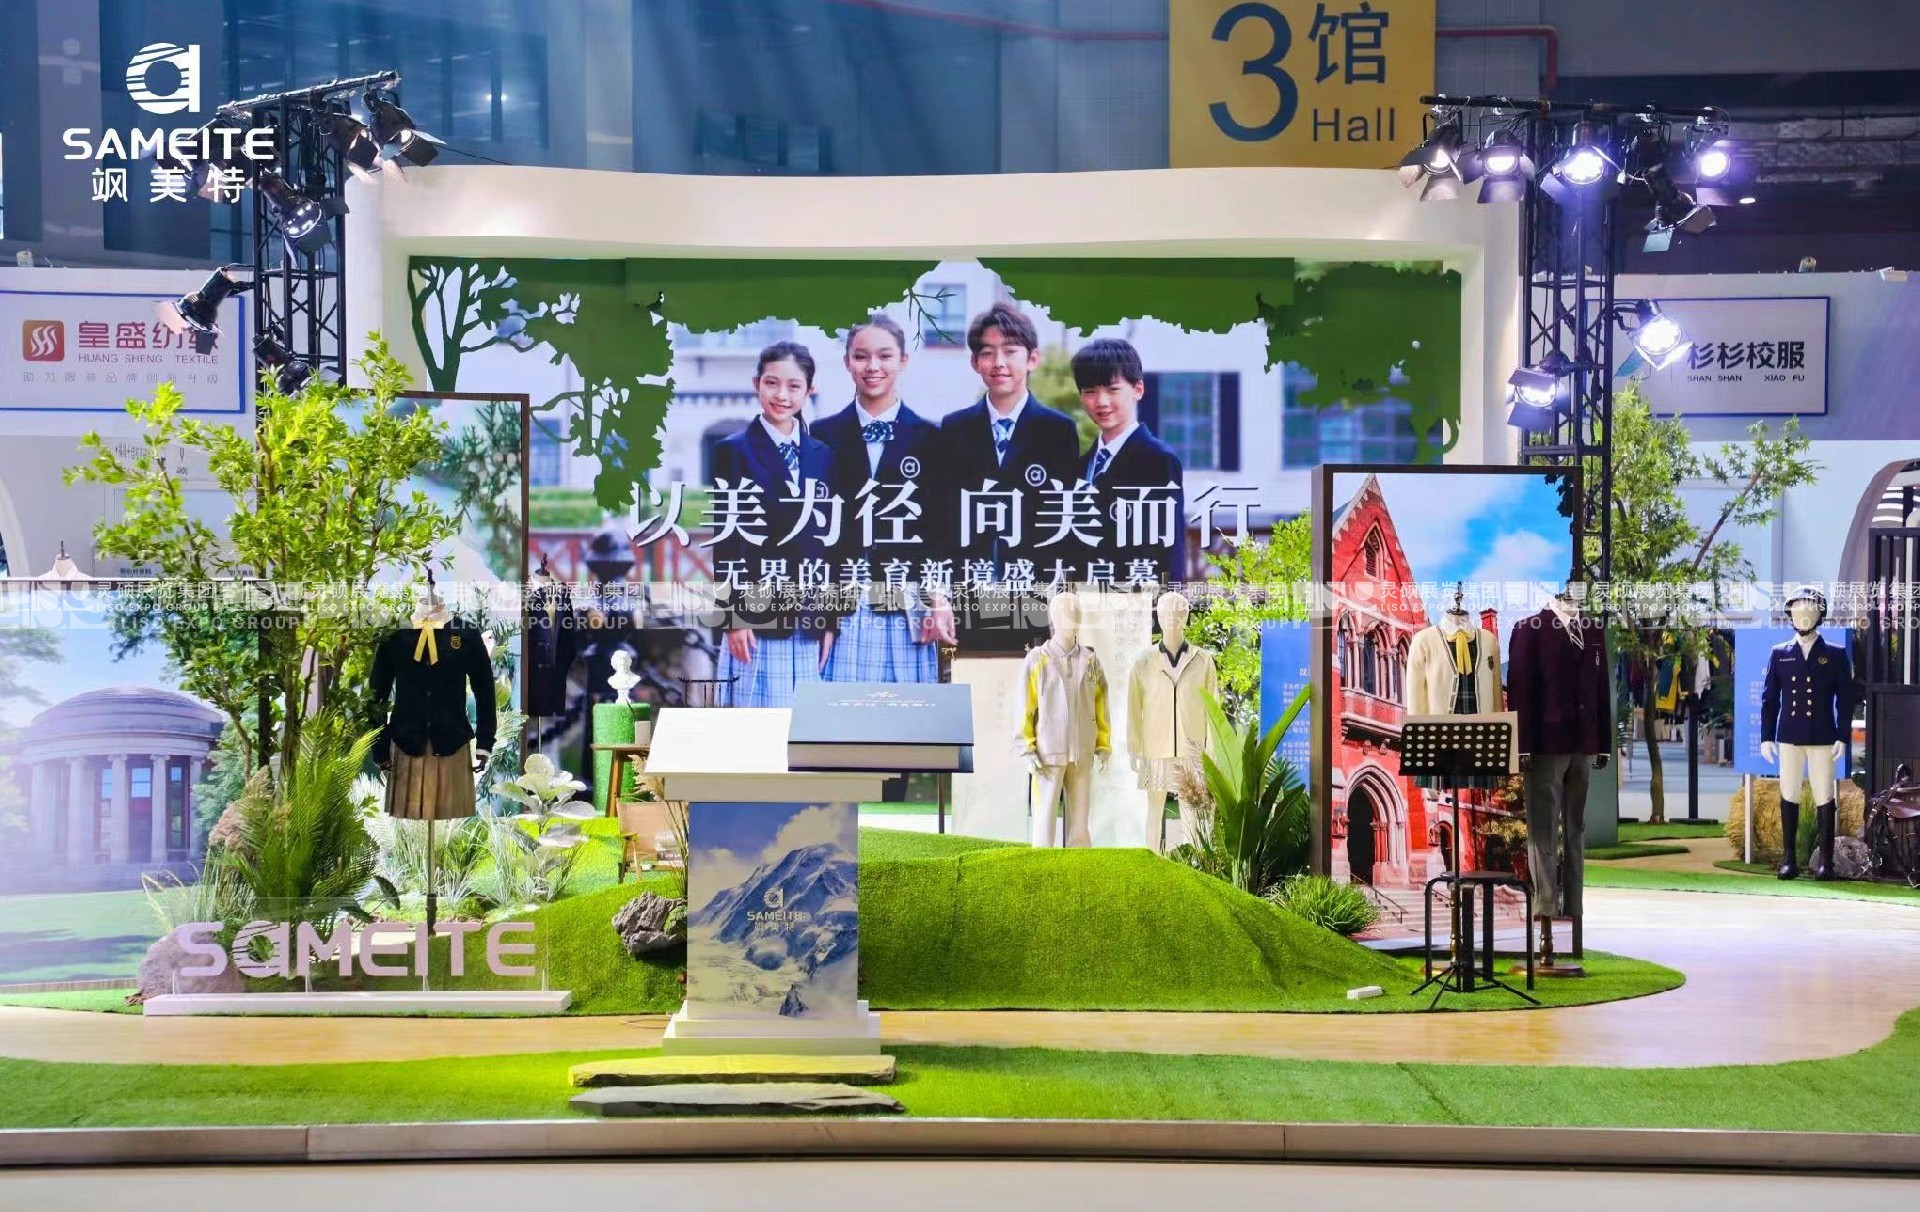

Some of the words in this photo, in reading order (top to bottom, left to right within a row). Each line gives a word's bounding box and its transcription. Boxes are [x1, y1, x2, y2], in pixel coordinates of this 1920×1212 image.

[1308, 1, 1389, 84] 馆
[1208, 2, 1298, 141] 3
[1313, 107, 1394, 141] Hall
[78, 353, 118, 364] HUANG
[125, 353, 163, 364] SHENG
[175, 354, 219, 365] TEXTILE
[1687, 341, 1805, 370] 杉杉校服
[625, 477, 923, 548] 以美为径
[960, 478, 1262, 549] 向美而行
[715, 558, 1159, 592] 无界的美育新境盛大启幕
[747, 911, 804, 921] SAMEITE
